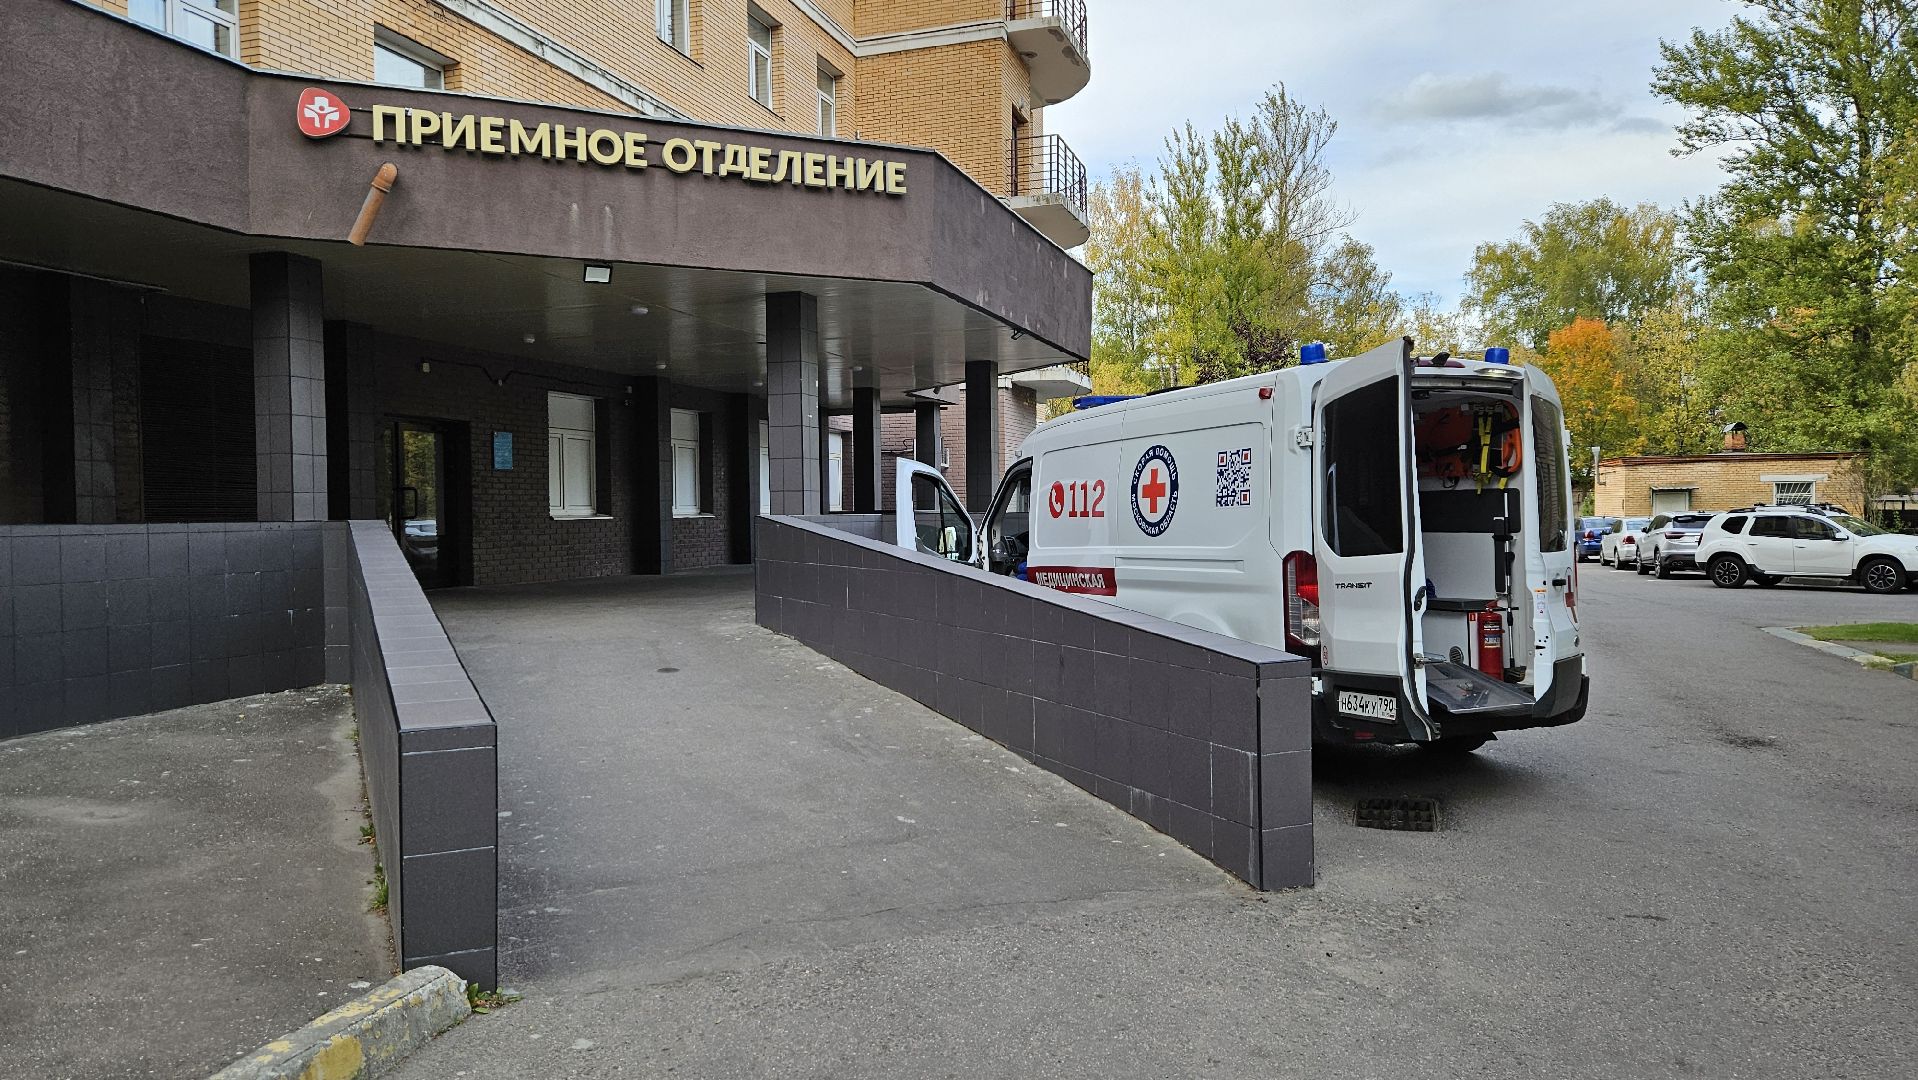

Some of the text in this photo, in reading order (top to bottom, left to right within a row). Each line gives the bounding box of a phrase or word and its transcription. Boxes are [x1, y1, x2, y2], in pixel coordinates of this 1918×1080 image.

[372, 104, 907, 194] ПРИЕМНОЕ ОТДЕЛЕНИЕ
[1133, 447, 1177, 485] СКОРАЯ ПОМОЩЬ
[1068, 479, 1105, 518] 112
[1131, 490, 1178, 535] МОСКОВСКАЯ ОБЛАСТЬ
[1035, 571, 1106, 590] МЕДИЦИНСКАЯ
[1335, 581, 1373, 590] TRANSIT
